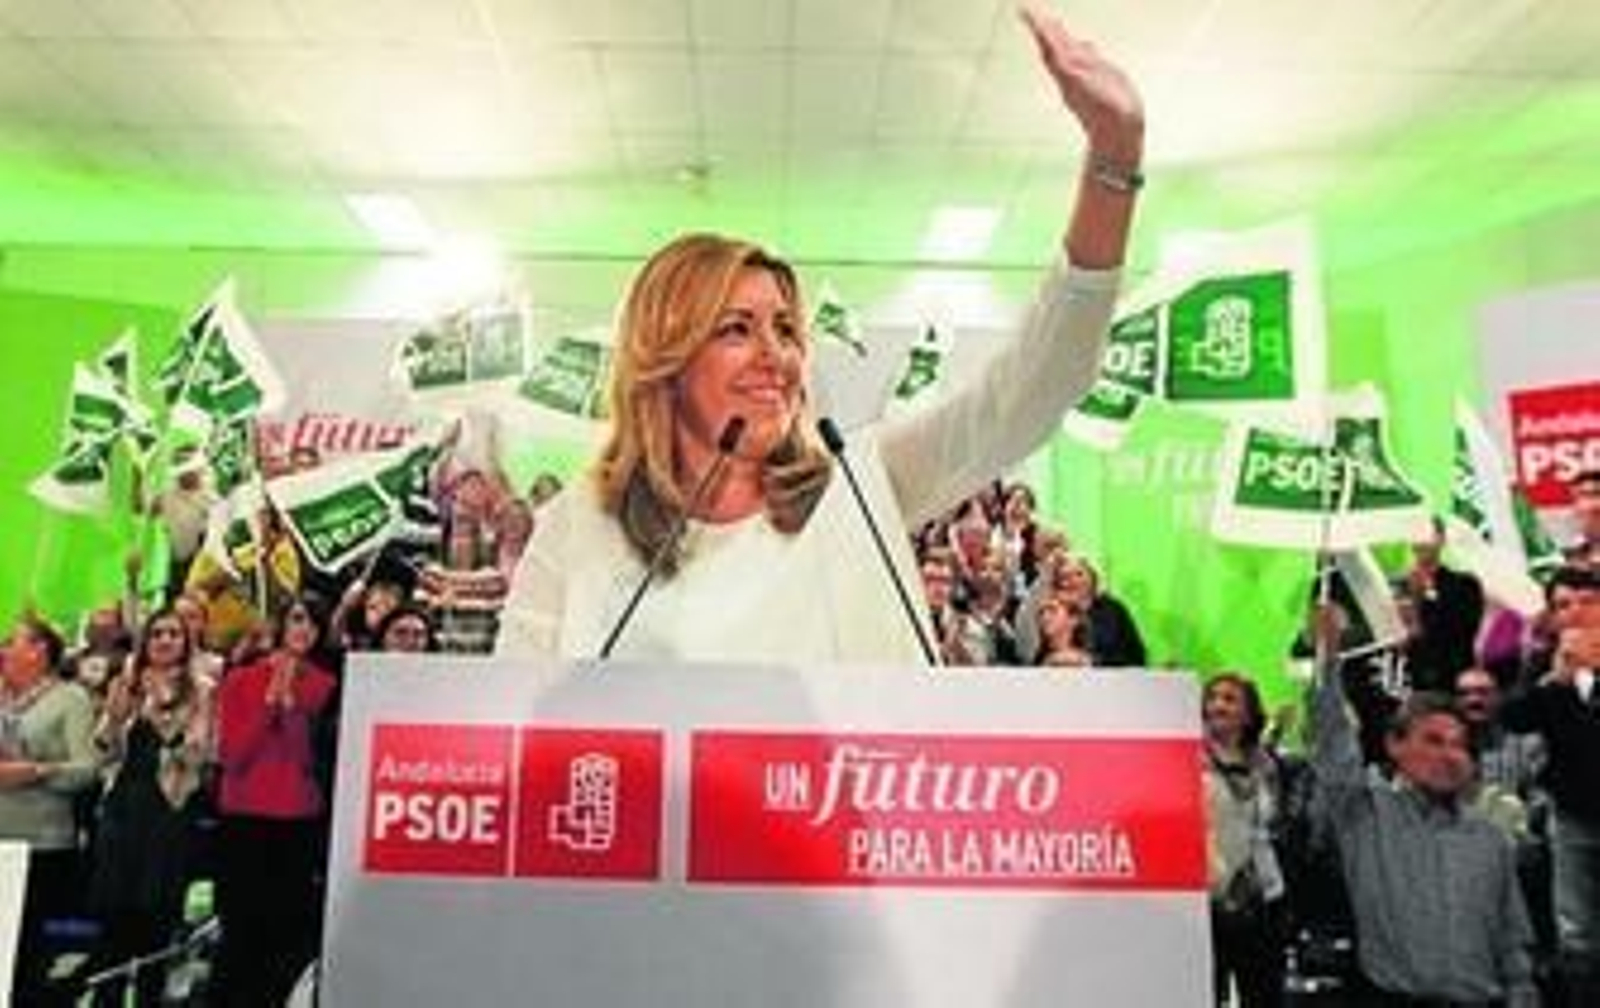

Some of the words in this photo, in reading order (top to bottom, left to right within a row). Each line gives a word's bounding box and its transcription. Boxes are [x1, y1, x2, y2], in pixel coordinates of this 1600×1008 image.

[765, 762, 811, 810] UN
[811, 744, 1060, 826] futuro
[374, 793, 500, 843] PSOE
[850, 829, 930, 876] PARA
[942, 829, 983, 876] LA
[991, 823, 1136, 878] MAYORÍA
